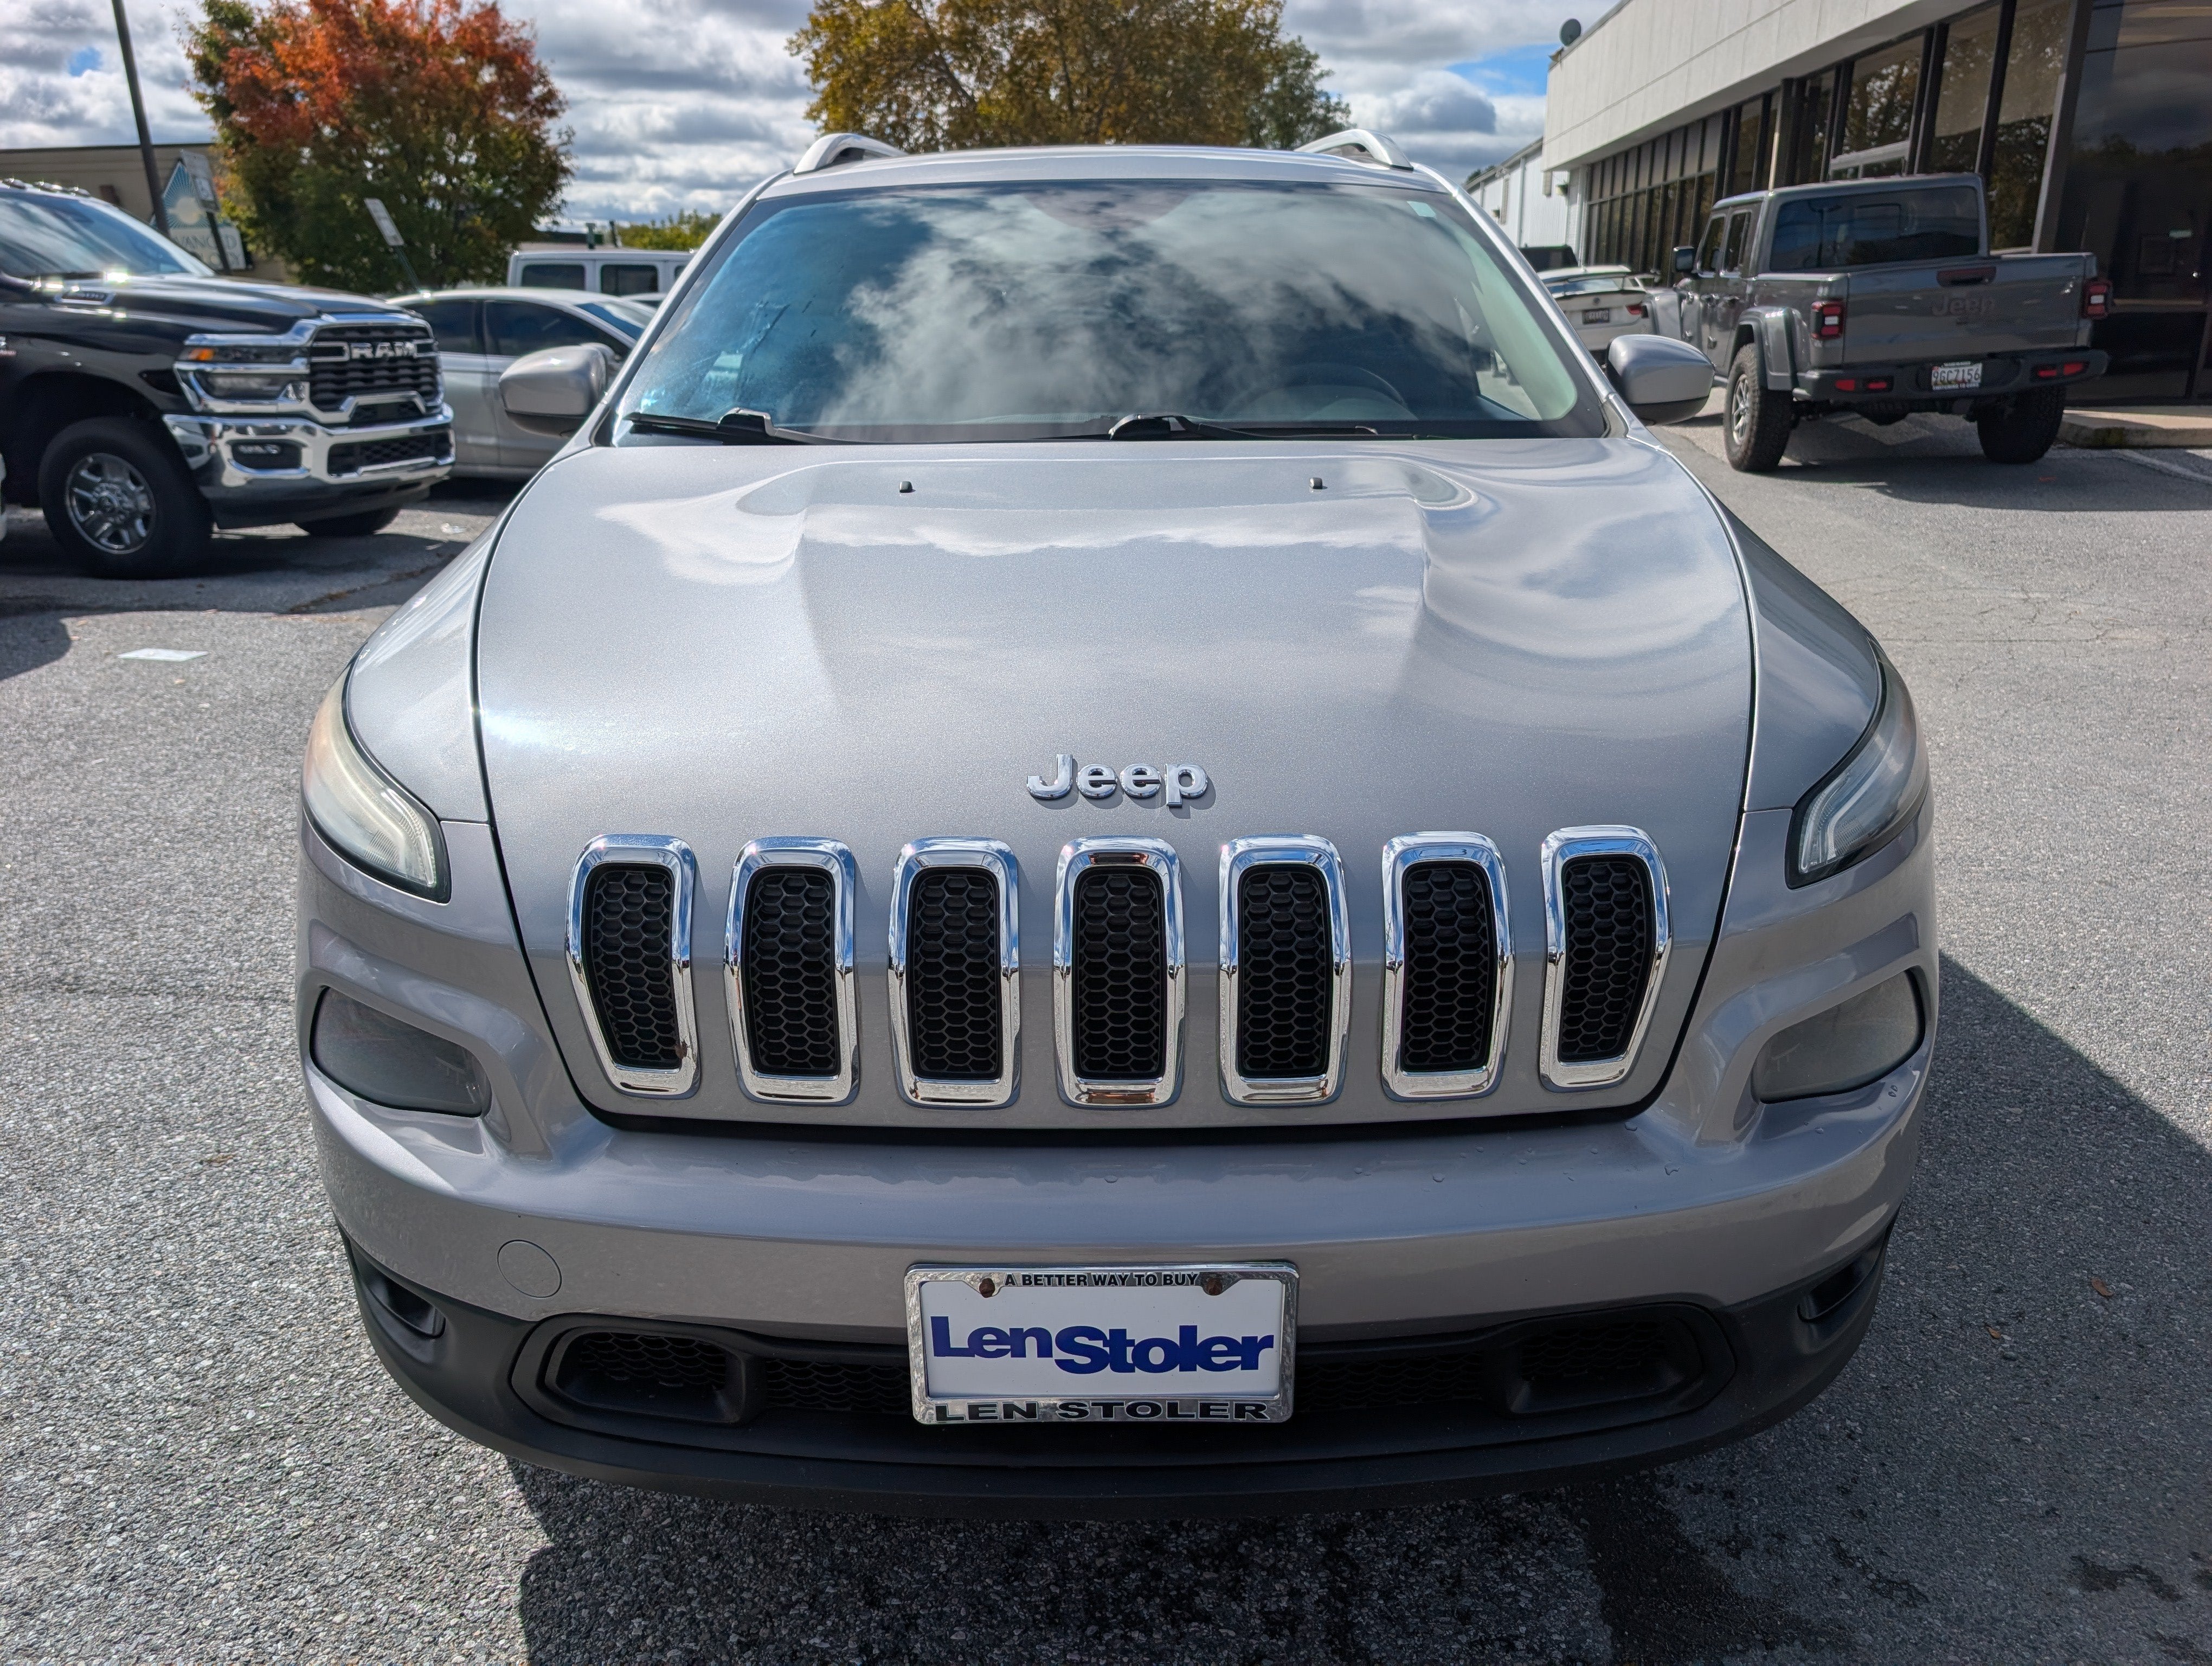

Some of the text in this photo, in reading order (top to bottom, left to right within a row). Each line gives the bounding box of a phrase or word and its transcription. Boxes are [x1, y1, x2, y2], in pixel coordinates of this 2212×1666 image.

[351, 342, 417, 358] RAM
[1026, 754, 1208, 808] Jeep
[1005, 1273, 1199, 1286] A BETTER WAY TO BUY
[930, 1316, 1275, 1374] LenStoler
[935, 1401, 1269, 1421] LEN STOLER
